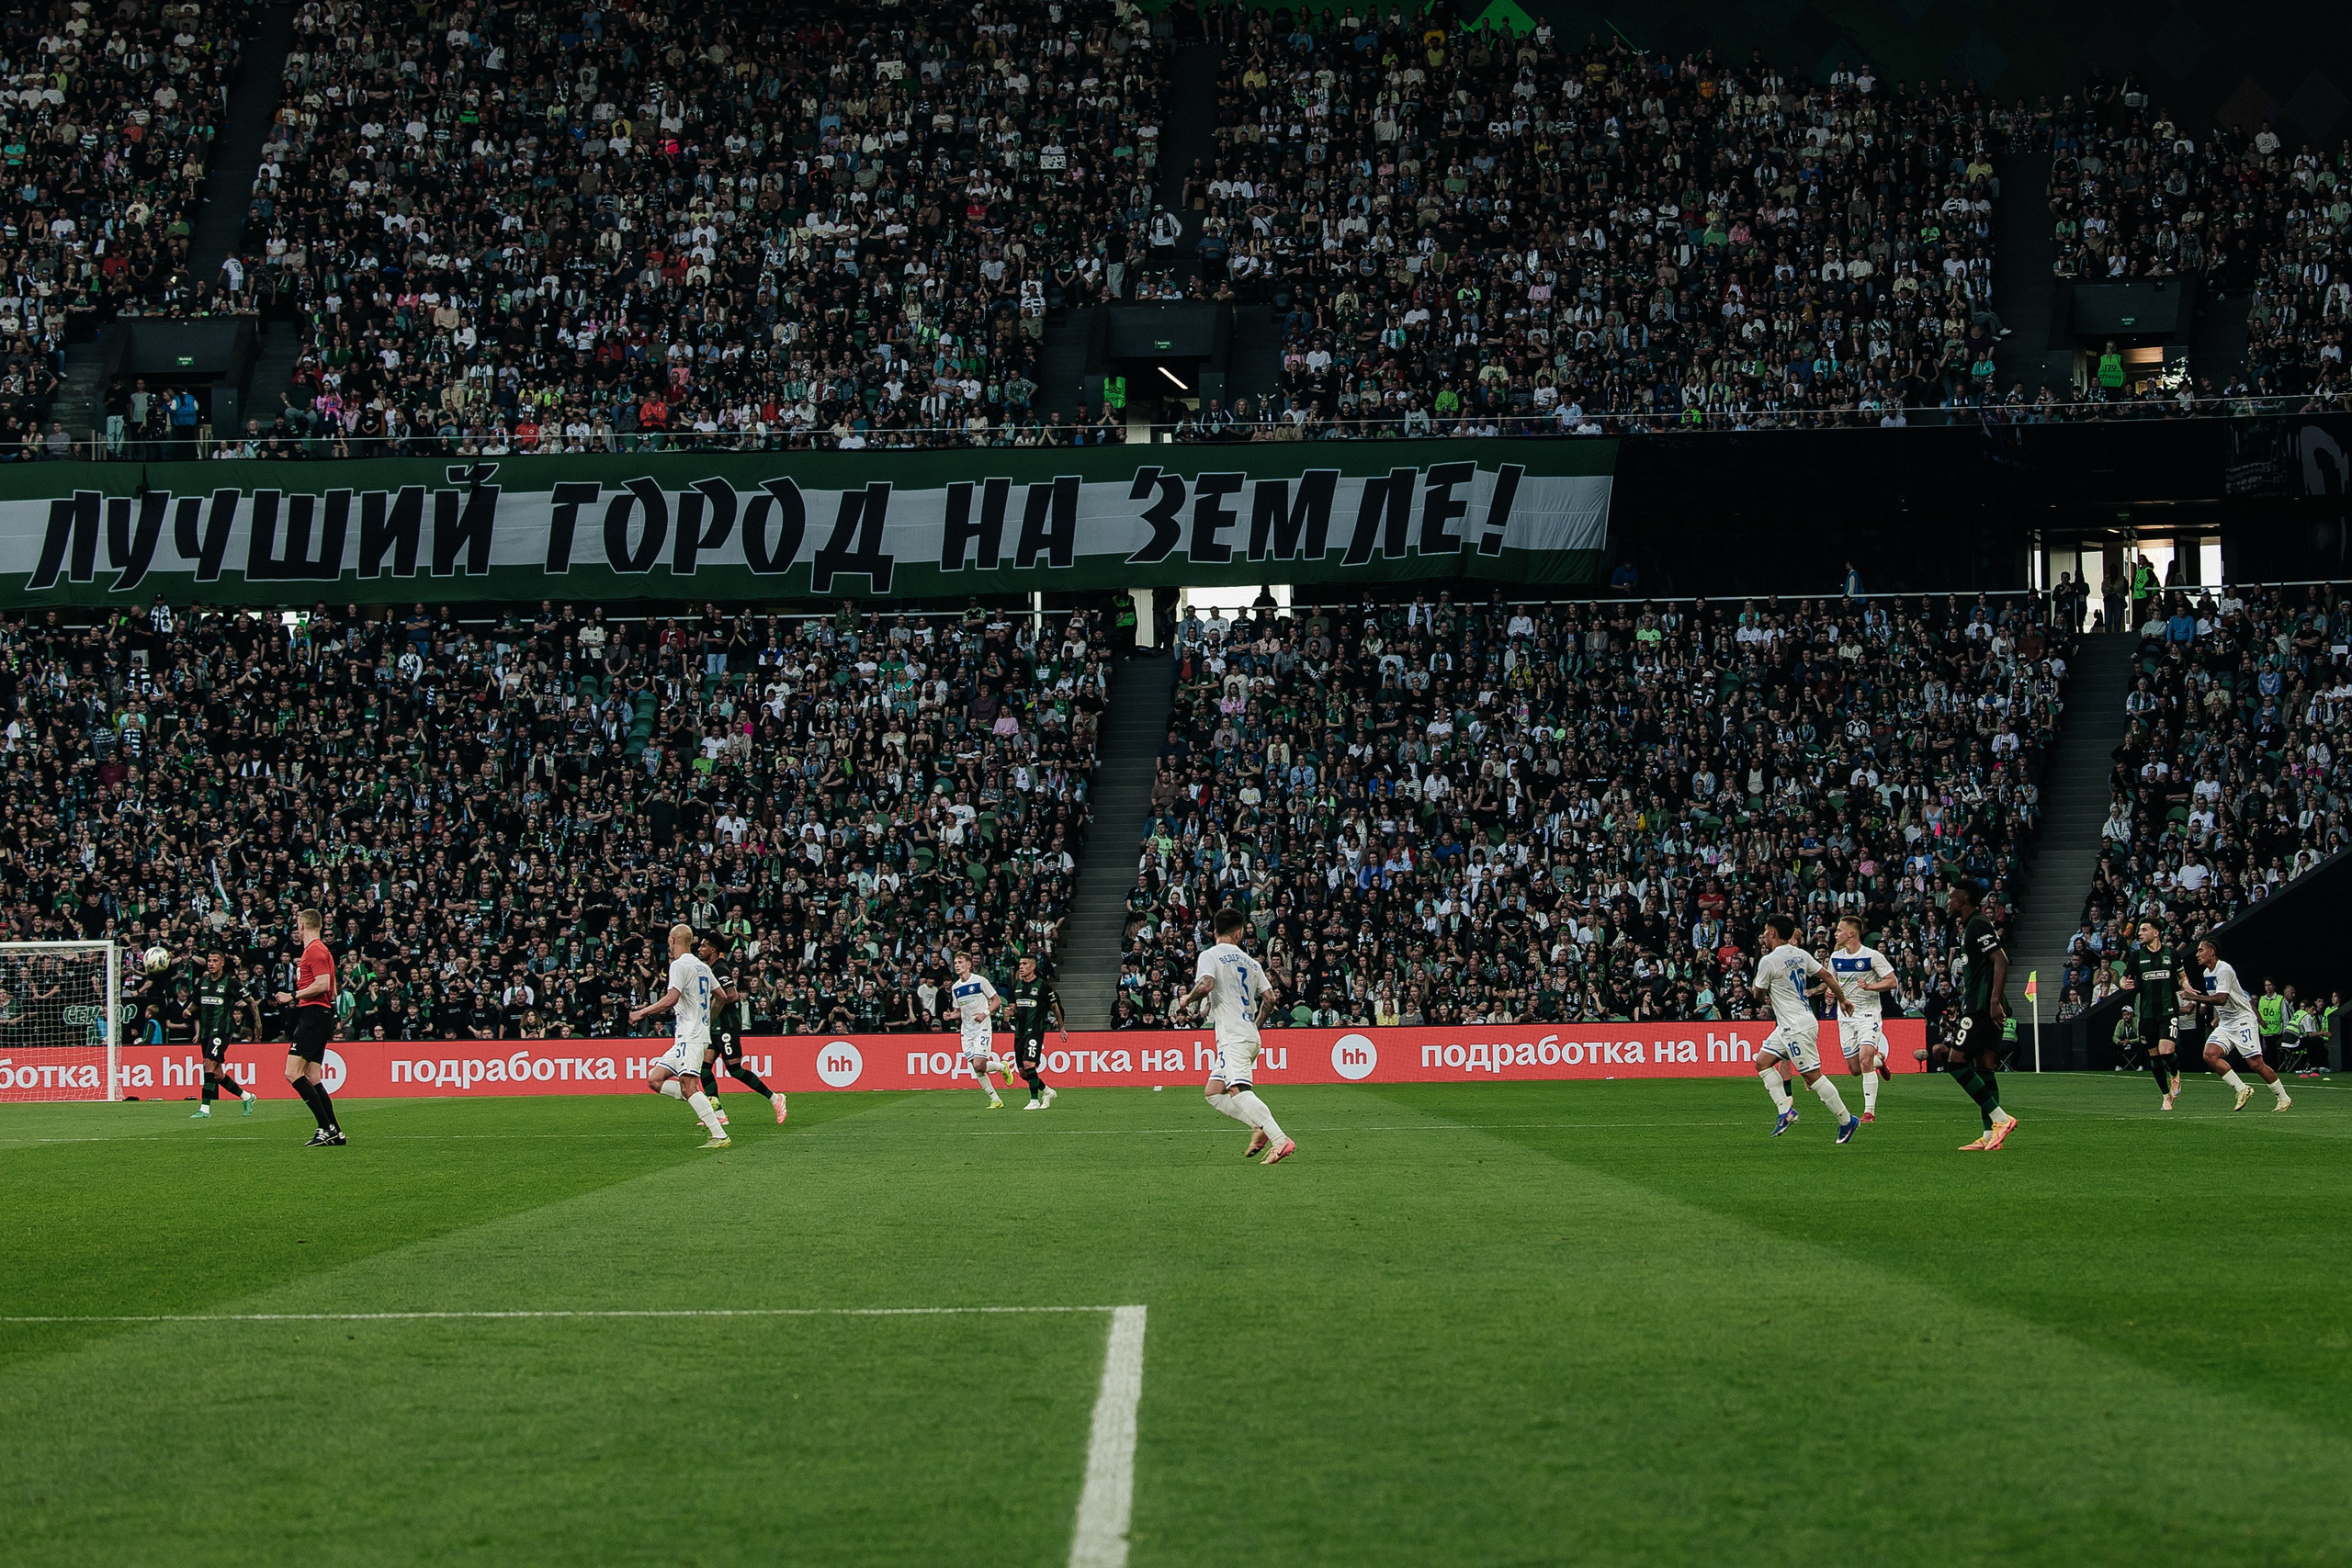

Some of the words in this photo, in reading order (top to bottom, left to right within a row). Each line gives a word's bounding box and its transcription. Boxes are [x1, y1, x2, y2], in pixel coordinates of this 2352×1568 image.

[25, 462, 501, 592] ЛУЧШИЙ
[545, 476, 894, 594] ГОРОД
[940, 474, 1082, 572] НА
[1125, 460, 1526, 567] ЗЕМЛЕ!
[1237, 966, 1250, 1006] 3
[1955, 1029, 1967, 1046] 9
[2169, 1025, 2178, 1039] 10
[2240, 1028, 2252, 1043] 37
[724, 1043, 733, 1055] 6
[980, 1036, 990, 1047] 27
[1788, 1041, 1802, 1057] 16
[211, 1045, 219, 1057] 4
[1028, 1046, 1037, 1058] 15
[1218, 1051, 1226, 1068] 3
[1342, 1048, 1367, 1065] hh
[1421, 1034, 1645, 1073] подработка
[1654, 1040, 1699, 1063] на
[828, 1055, 853, 1072] hh
[1141, 1049, 1186, 1072] на
[391, 1051, 616, 1089] подработка
